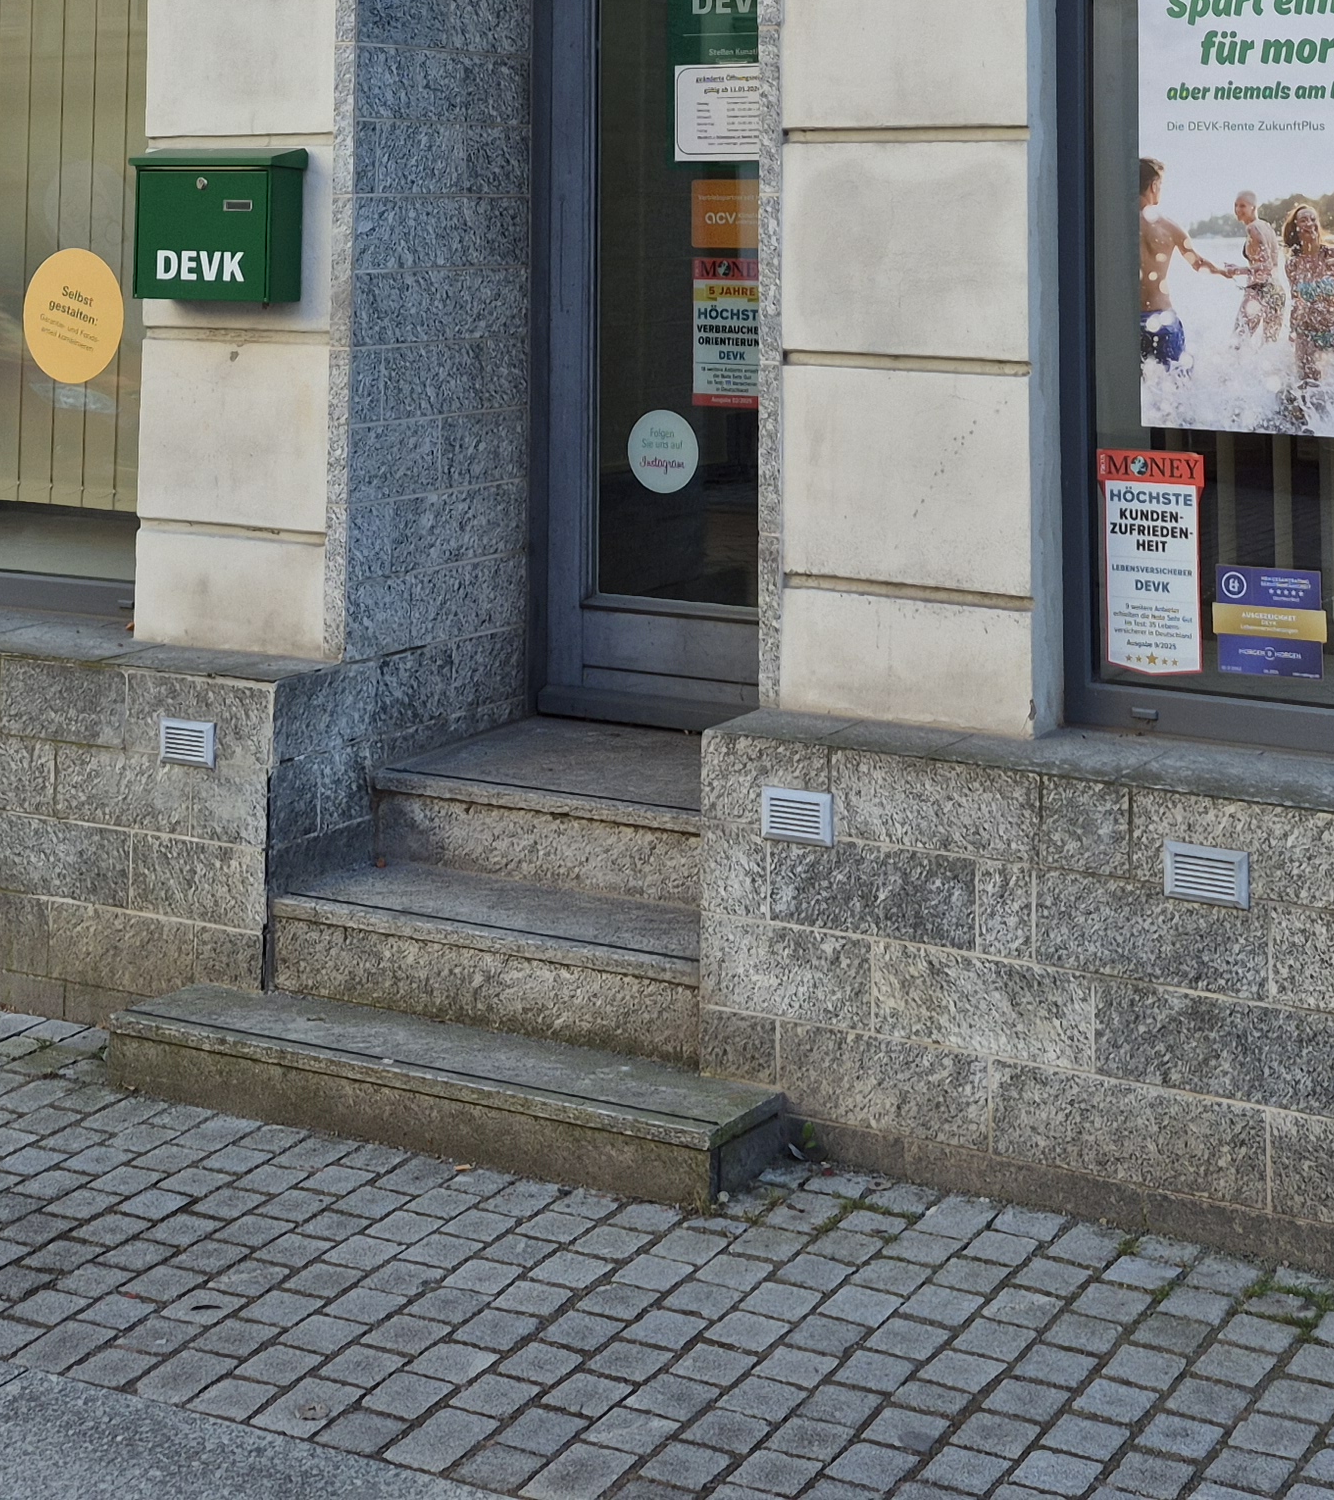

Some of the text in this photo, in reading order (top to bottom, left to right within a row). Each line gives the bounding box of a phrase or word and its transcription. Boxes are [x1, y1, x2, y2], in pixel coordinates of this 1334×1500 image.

[1200, 30, 1254, 67] für
[1166, 82, 1210, 101] aber
[1214, 80, 1291, 100] niemals
[1294, 84, 1326, 100] am
[1167, 120, 1325, 131] Die DEVK-Rente ZukunftPlus
[705, 212, 736, 224] acv
[156, 250, 244, 282] DEVK
[700, 260, 758, 278] MONE
[62, 285, 94, 307] Selbst
[708, 286, 755, 296] 5 JAHRE
[48, 300, 98, 326] gestalten:
[697, 305, 758, 321] HÖCHST
[697, 324, 758, 334] VERBRAUCHE
[698, 336, 759, 347] ORIENTIERUN
[718, 350, 745, 360] DEVK
[650, 427, 674, 440] Folgen
[642, 438, 683, 450] Sie uns auf
[639, 455, 685, 475] Instagram
[1109, 486, 1193, 507] HÖCHSTE
[1119, 508, 1184, 524] KUNDEN-
[1109, 522, 1194, 540] ZUFRIEDEN-
[1136, 539, 1167, 553] HEIT
[1111, 563, 1193, 577] LEBENSVERSICHERER
[1134, 579, 1170, 593] DEVK
